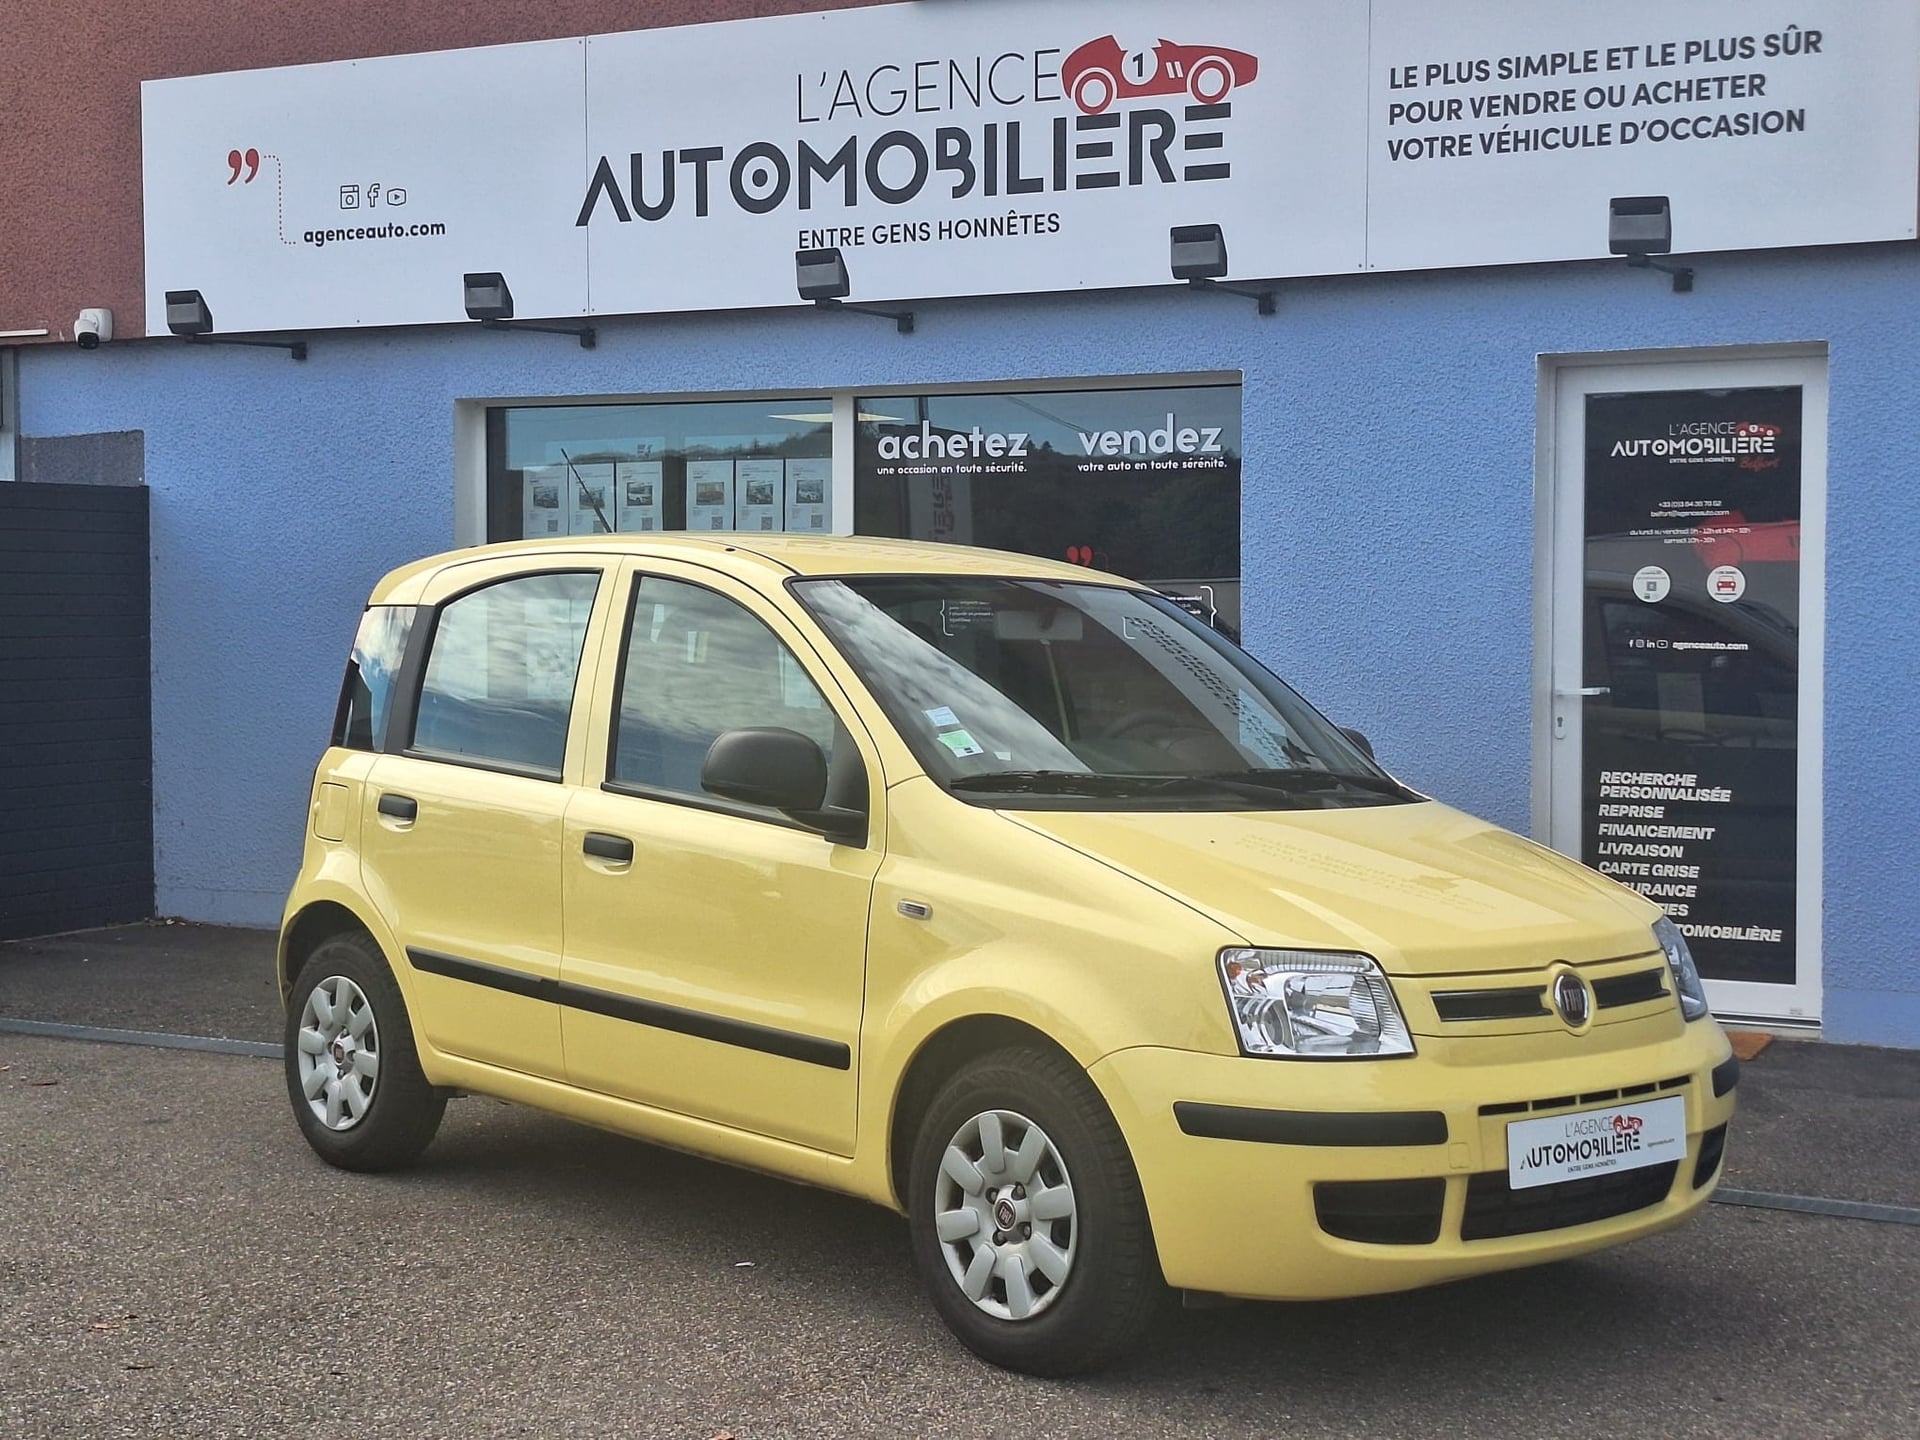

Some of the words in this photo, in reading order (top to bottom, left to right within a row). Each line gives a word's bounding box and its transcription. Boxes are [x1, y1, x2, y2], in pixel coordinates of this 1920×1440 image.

[1390, 66, 1418, 89] LE
[1425, 60, 1490, 86] PLUS
[1497, 50, 1598, 80] SIMPLE
[1606, 46, 1639, 71] ET
[1645, 43, 1676, 67] LE
[1684, 36, 1756, 64] PLUS
[1763, 25, 1823, 57] SÛR
[798, 49, 1061, 123] L'AGENCE
[1389, 99, 1463, 125] POUR
[1469, 89, 1576, 120] VENDRE
[1584, 85, 1626, 110] OU
[1632, 73, 1766, 106] ACHETER
[1388, 134, 1473, 161] VOTRE
[1479, 123, 1612, 154] VÉHICULE
[1620, 109, 1805, 145] D'OCCASION
[303, 220, 446, 247] agenceauto.com
[799, 223, 866, 249] ENTRE
[871, 221, 931, 246] GENS
[938, 210, 1060, 240] HONNÊTES
[1078, 412, 1223, 456] vendez
[1669, 422, 1736, 436] L'AGENCE
[877, 419, 1030, 460] achetez
[877, 467, 894, 475] une
[898, 464, 938, 475] occasion
[941, 466, 953, 474] en
[956, 464, 982, 473] toute
[985, 461, 1028, 473] sécurité.
[1078, 462, 1104, 472] votre
[1107, 461, 1131, 471] auto
[1135, 462, 1147, 470] en
[1151, 460, 1178, 470] toute
[1600, 771, 1698, 787] RECHERCHE
[1599, 785, 1732, 803] PERSONNALISÉE
[1598, 804, 1665, 819] REPRISE
[1598, 823, 1716, 840] FINANCEMENT
[1598, 842, 1684, 858] LIVRAISON
[1598, 861, 1650, 876] CARTE
[1651, 863, 1700, 879] GRISE
